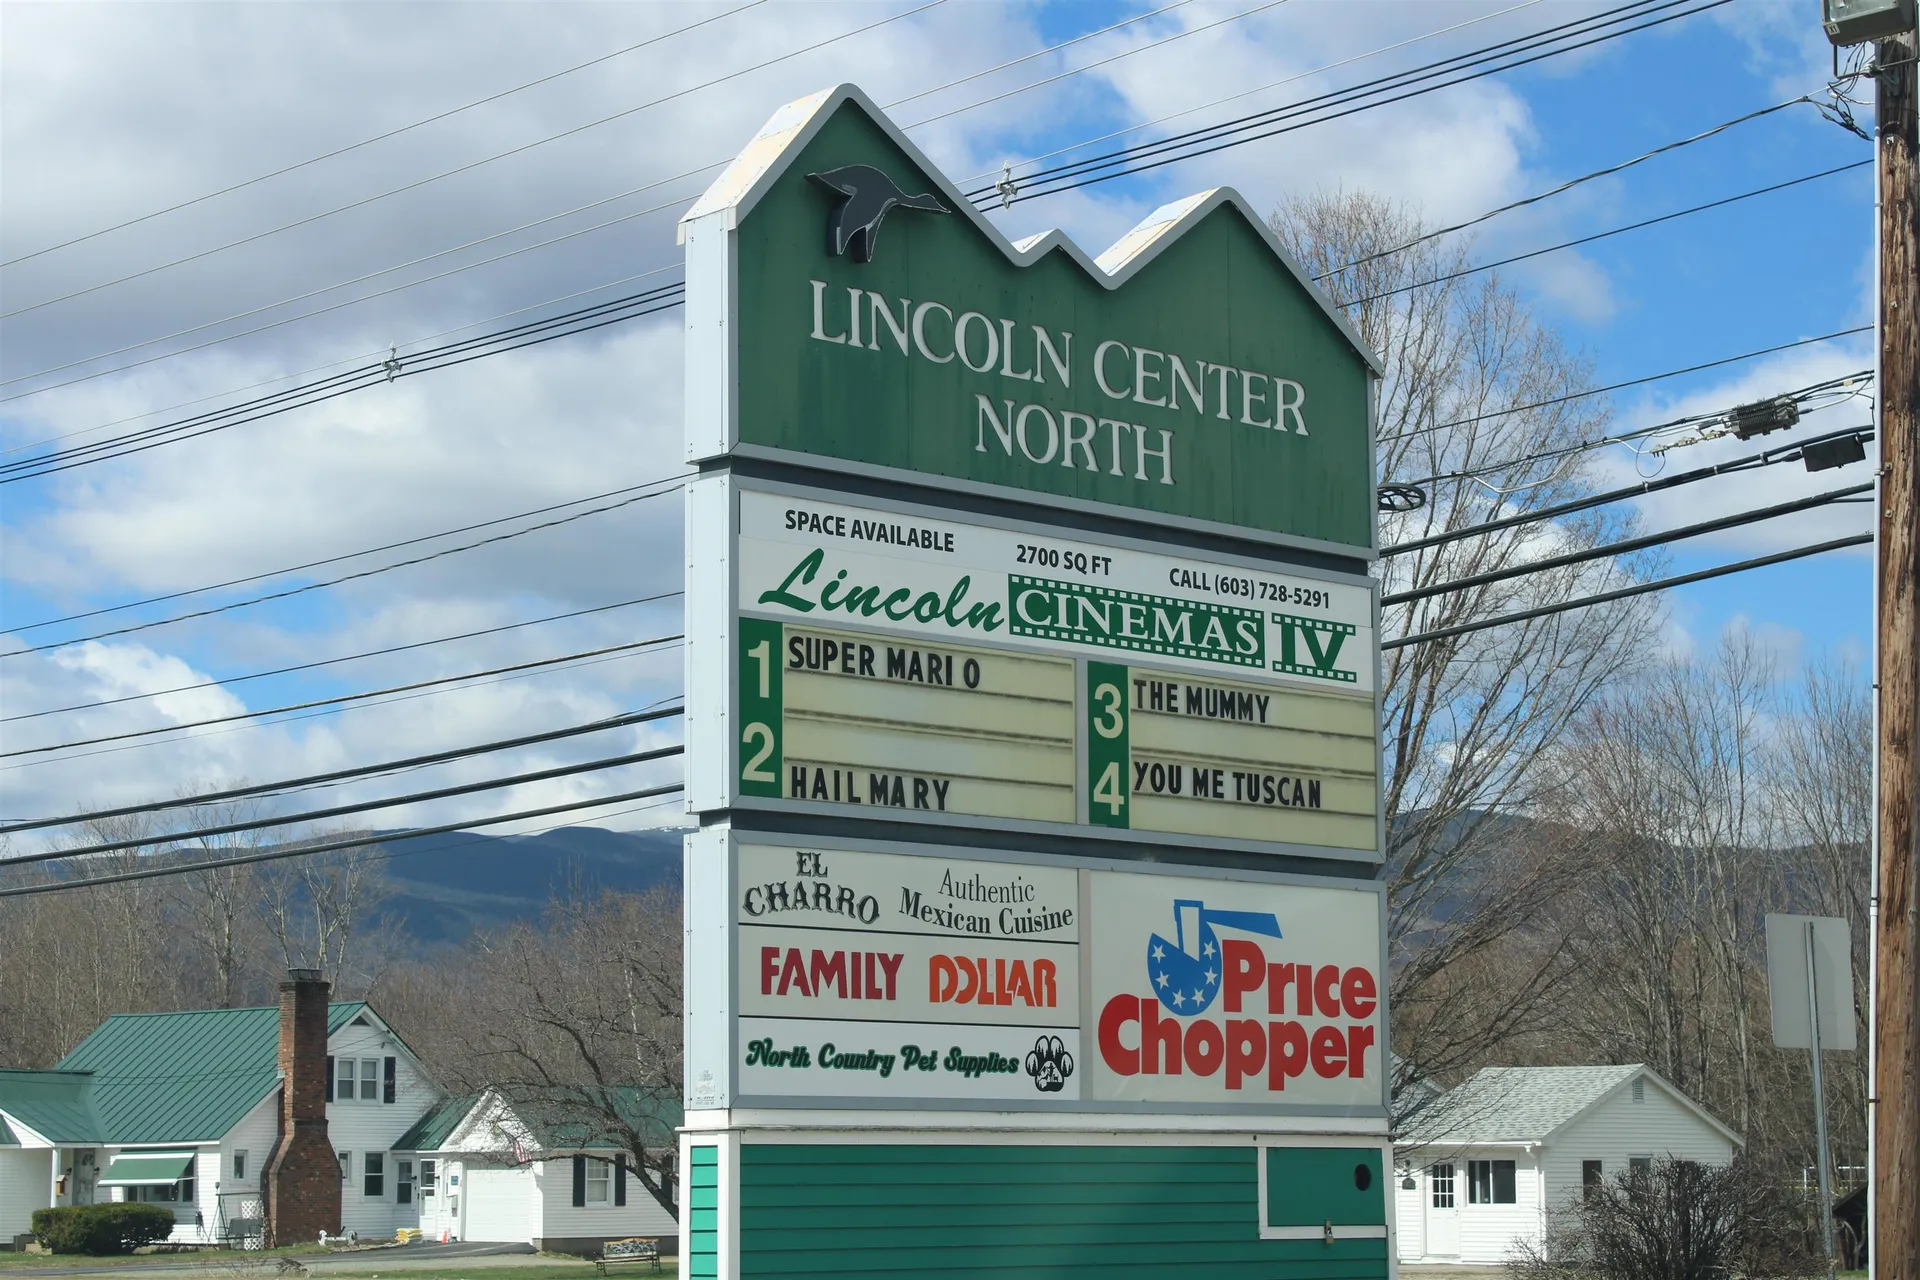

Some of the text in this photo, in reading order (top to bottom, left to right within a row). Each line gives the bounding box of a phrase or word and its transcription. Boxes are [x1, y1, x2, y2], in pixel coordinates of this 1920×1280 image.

[810, 279, 1309, 436] LINCOLN CENTER
[975, 394, 1176, 485] NORTH
[785, 509, 954, 552] SPACE AVAILABLE
[1016, 545, 1111, 576] 2700 SQ FT
[1169, 568, 1330, 609] CALL (603) 728-5291
[759, 548, 1357, 683] Lincoln CINEMAS IV
[748, 640, 770, 698] 1
[788, 636, 875, 677] SUPER
[1093, 682, 1124, 739] 3
[1133, 679, 1270, 723] THE MUMMY
[742, 722, 775, 783] 2
[791, 766, 950, 811] HAIL MARY
[1093, 761, 1124, 816] 4
[1133, 761, 1321, 808] YOU ME TUSCAN
[796, 850, 828, 878] EL
[938, 868, 1035, 904] Authentic
[742, 880, 880, 925] CHARRO
[899, 886, 1074, 935] Mexican Cuisine
[761, 946, 1057, 1008] FAMILY DOLLAR
[1222, 939, 1377, 1020] Price
[745, 1037, 1020, 1078] North Country Pet Supplies
[1098, 993, 1374, 1091] Chopper
